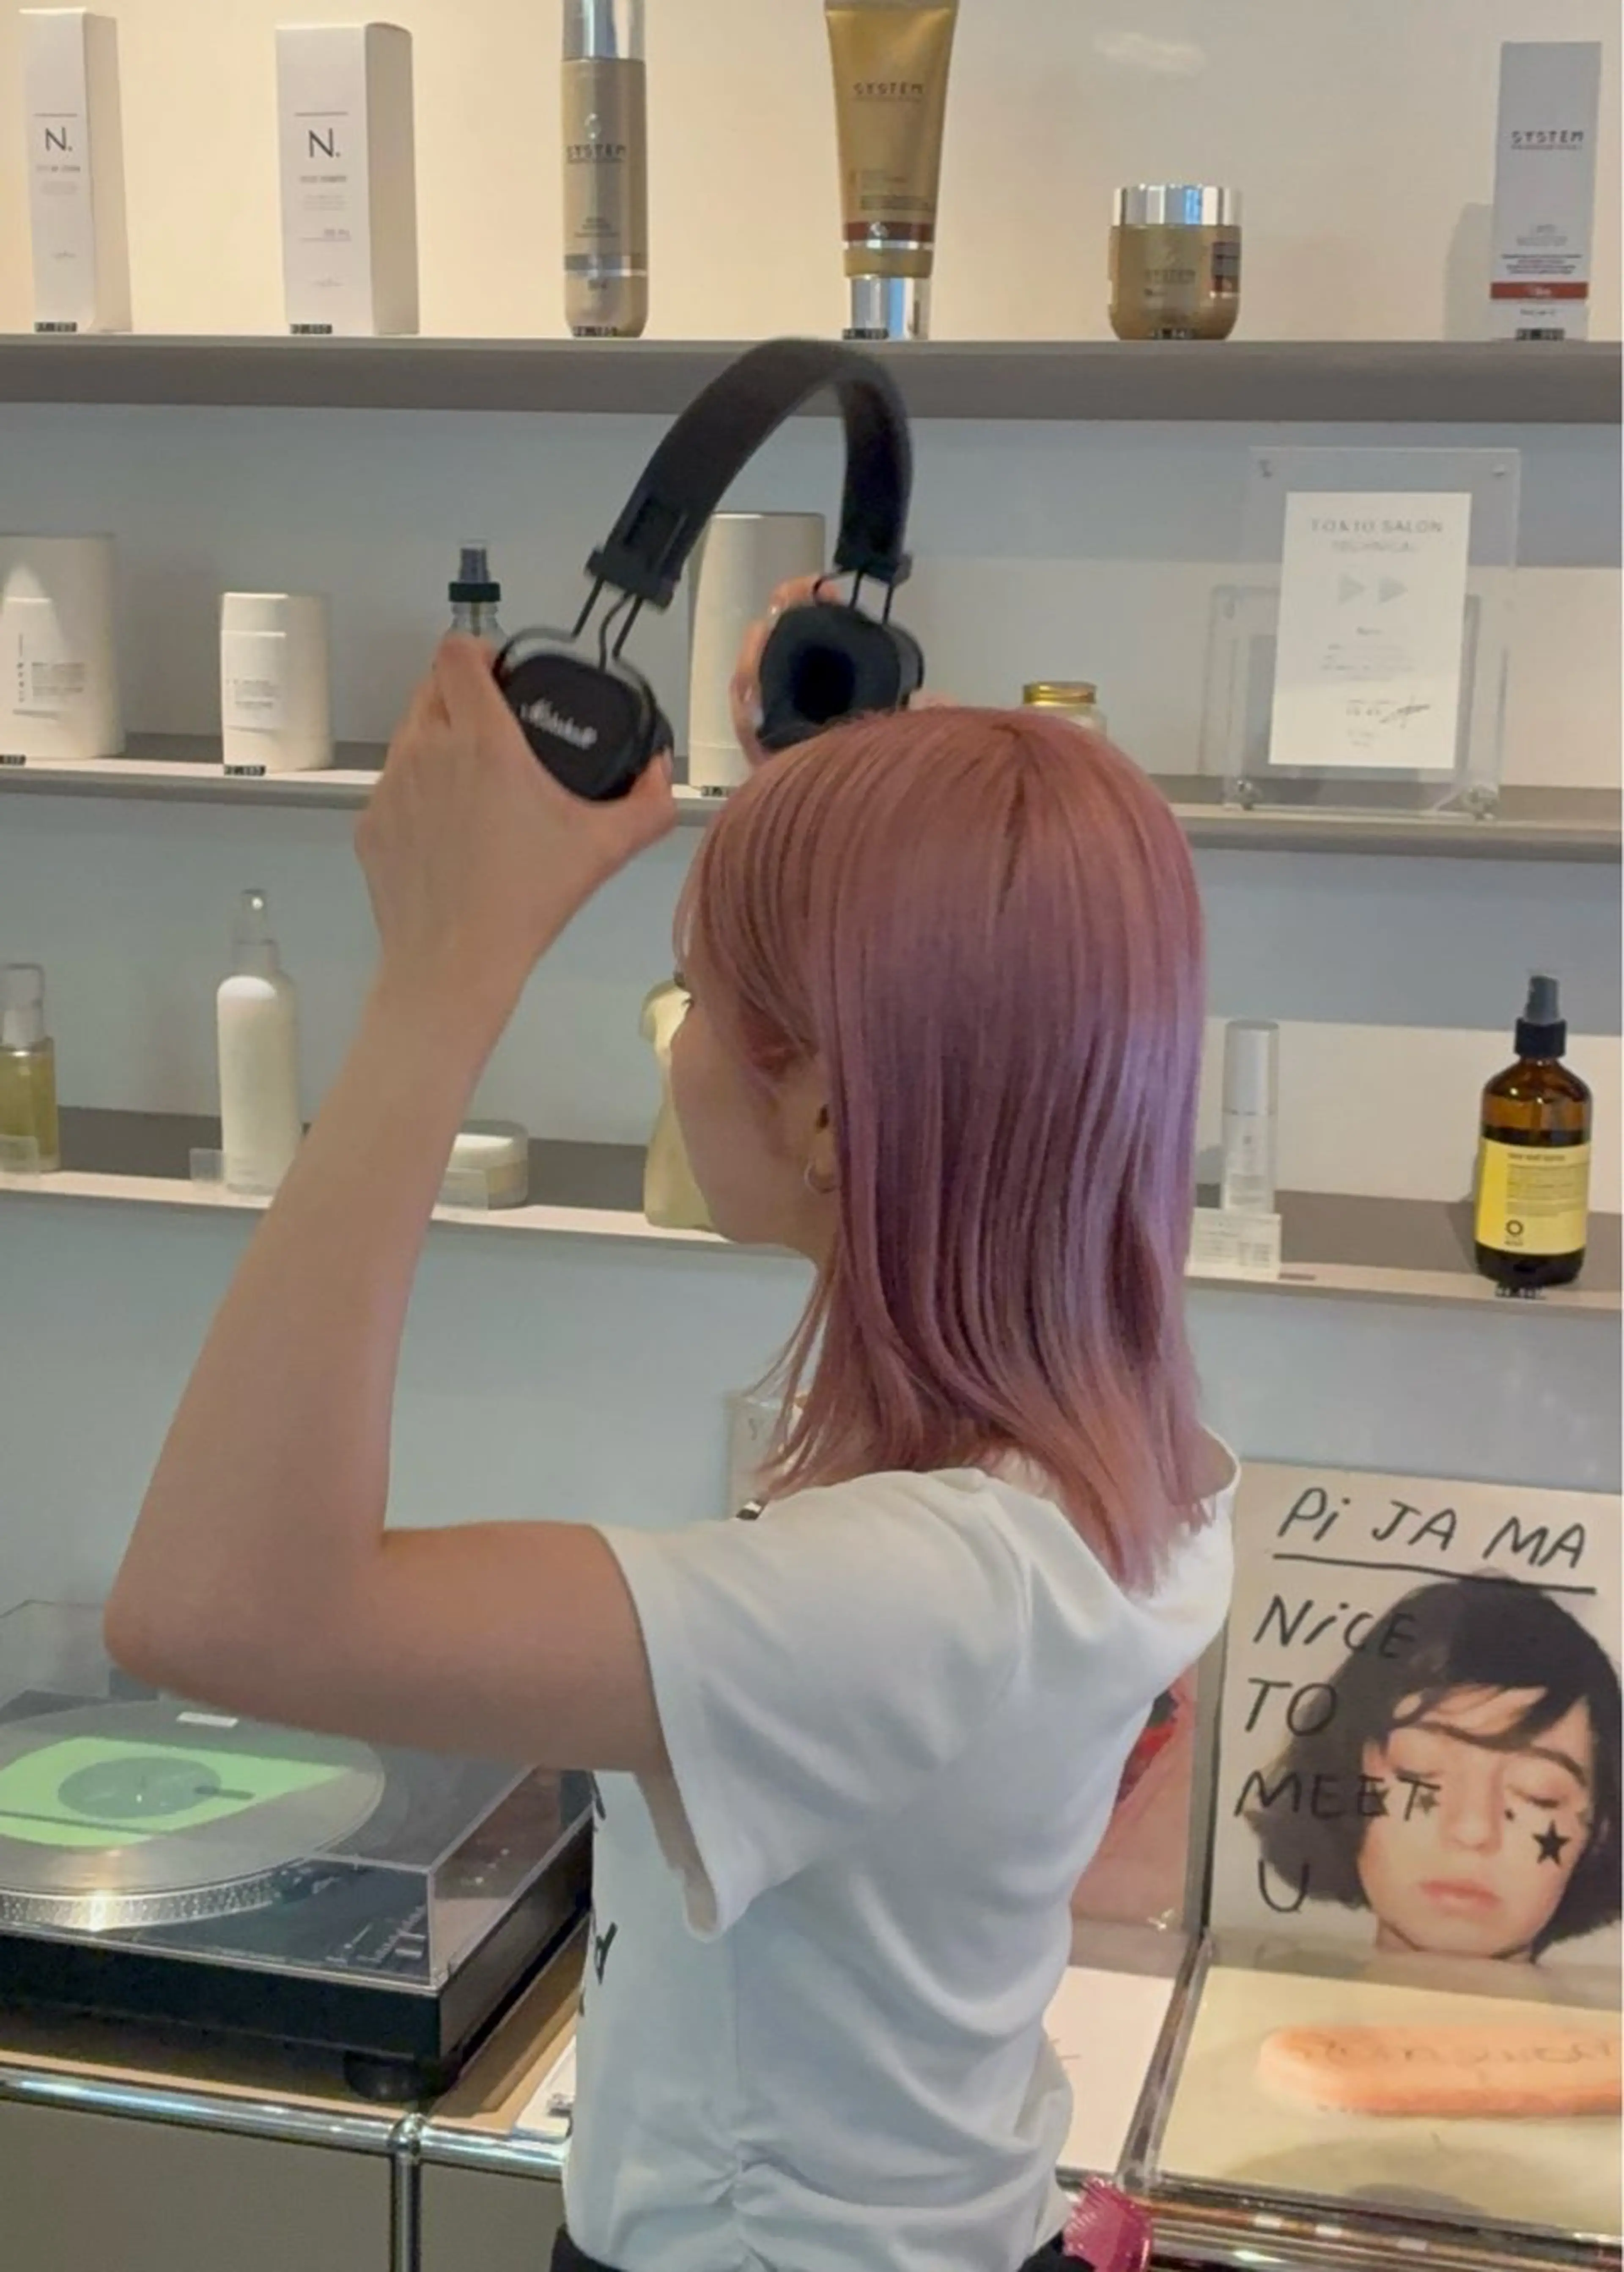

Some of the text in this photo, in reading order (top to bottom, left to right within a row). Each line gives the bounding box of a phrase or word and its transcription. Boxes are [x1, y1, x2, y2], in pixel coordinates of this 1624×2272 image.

[44, 126, 72, 152] N.
[308, 128, 341, 158] N.
[1511, 129, 1584, 143] SYSTEM
[1245, 1677, 1338, 1737] TO
[1232, 1770, 1443, 1822] MEET
[1257, 1860, 1310, 1912] U
